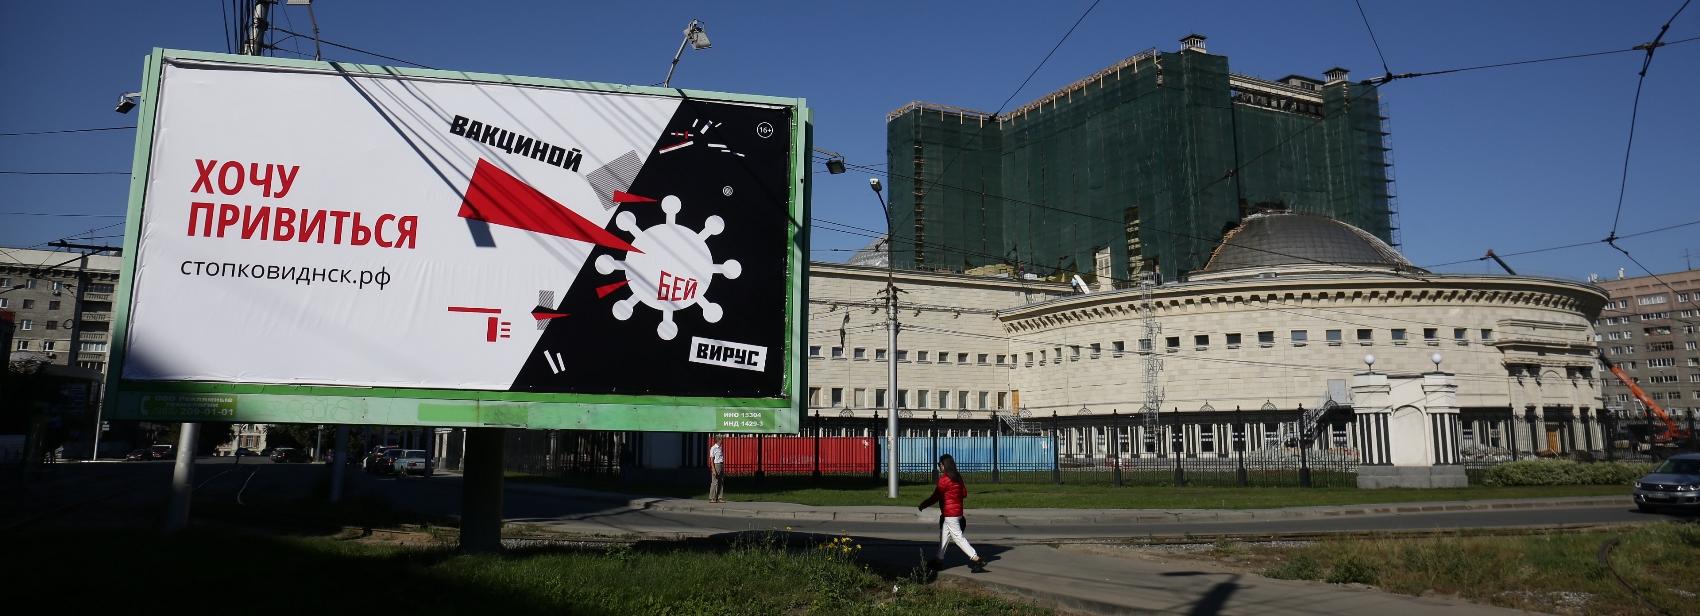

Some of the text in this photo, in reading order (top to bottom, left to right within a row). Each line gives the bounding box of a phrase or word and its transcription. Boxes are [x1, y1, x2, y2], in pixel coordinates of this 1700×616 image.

[450, 115, 582, 172] ВАКЦИНОЙ
[191, 159, 300, 199] ХОЧУ
[187, 202, 418, 249] ПРИВИТЬСЯ
[180, 260, 391, 290] стопковиднск.рф
[657, 270, 698, 301] БЕЙ
[696, 343, 760, 366] ВИРУС
